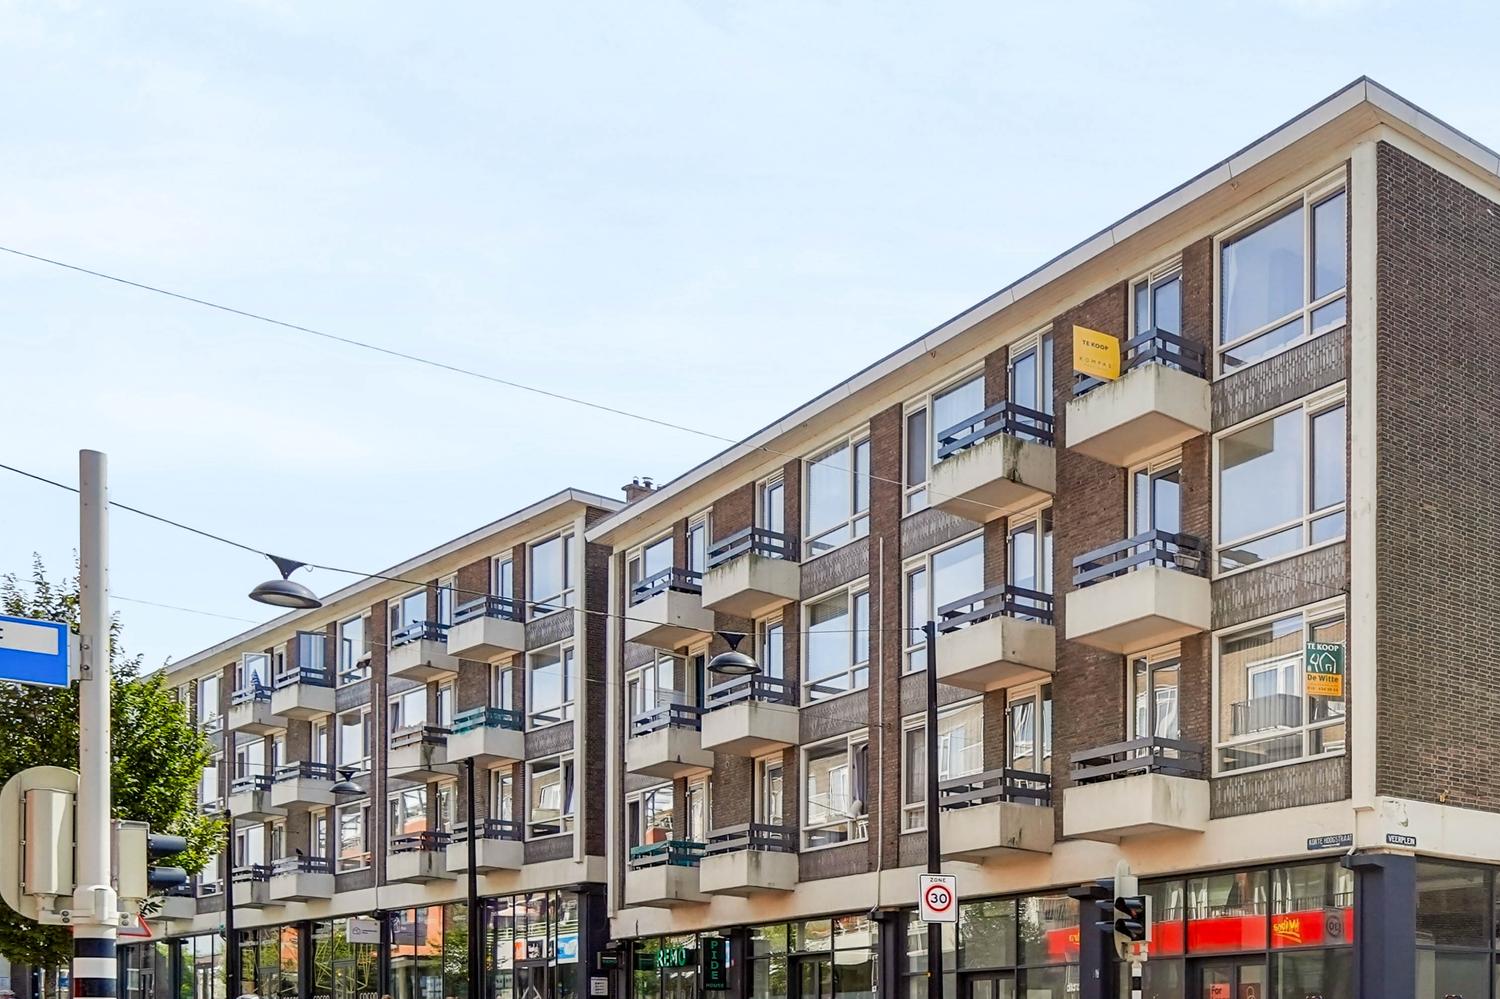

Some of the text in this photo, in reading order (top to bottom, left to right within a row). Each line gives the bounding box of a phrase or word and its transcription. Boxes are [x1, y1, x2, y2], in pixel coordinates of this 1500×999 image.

[1090, 342, 1109, 351] KOOP
[1307, 642, 1340, 652] TE KOOP
[1307, 673, 1339, 683] De Witte
[930, 893, 947, 904] 30
[657, 948, 687, 968] REMO
[711, 940, 719, 980] PIDE
